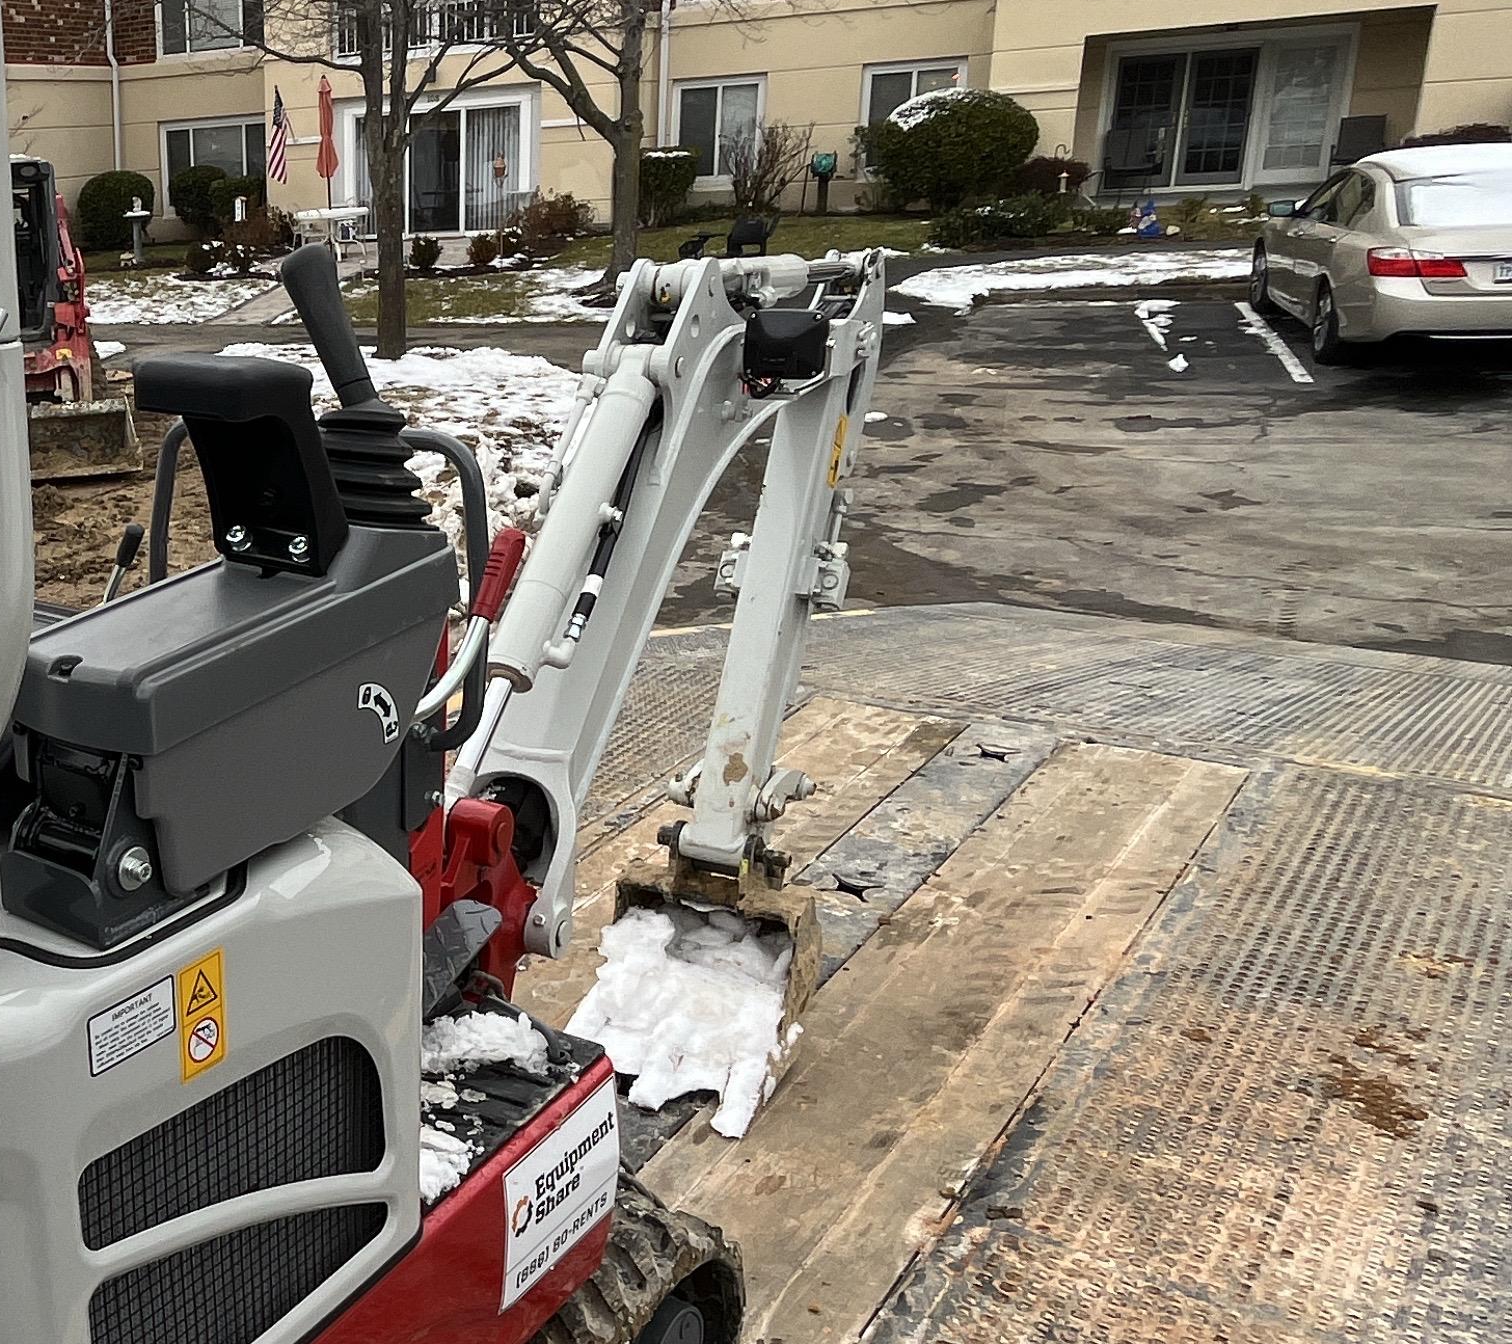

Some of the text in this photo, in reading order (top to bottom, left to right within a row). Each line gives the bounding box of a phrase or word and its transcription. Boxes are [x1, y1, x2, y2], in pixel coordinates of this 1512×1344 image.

[111, 992, 153, 1022] IMPORTANT
[534, 1110, 615, 1202] Equipment
[534, 1171, 582, 1225] Share
